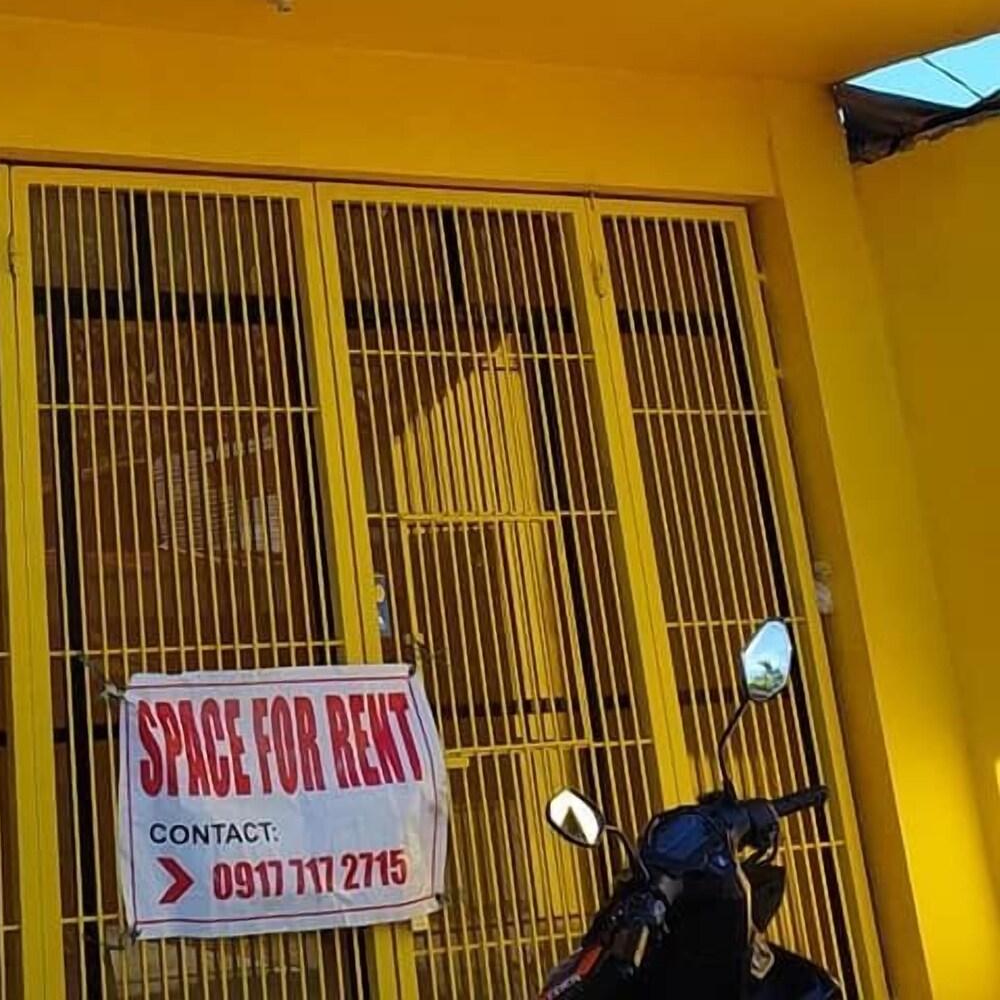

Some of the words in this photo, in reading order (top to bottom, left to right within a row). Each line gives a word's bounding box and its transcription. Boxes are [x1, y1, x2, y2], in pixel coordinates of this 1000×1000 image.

[138, 698, 251, 797] SPACE
[252, 696, 325, 795] FOR
[325, 692, 423, 788] RENT
[150, 822, 279, 845] CONTACT:
[213, 860, 281, 900] 0917
[289, 856, 333, 895] 717
[341, 850, 408, 890] 2715
